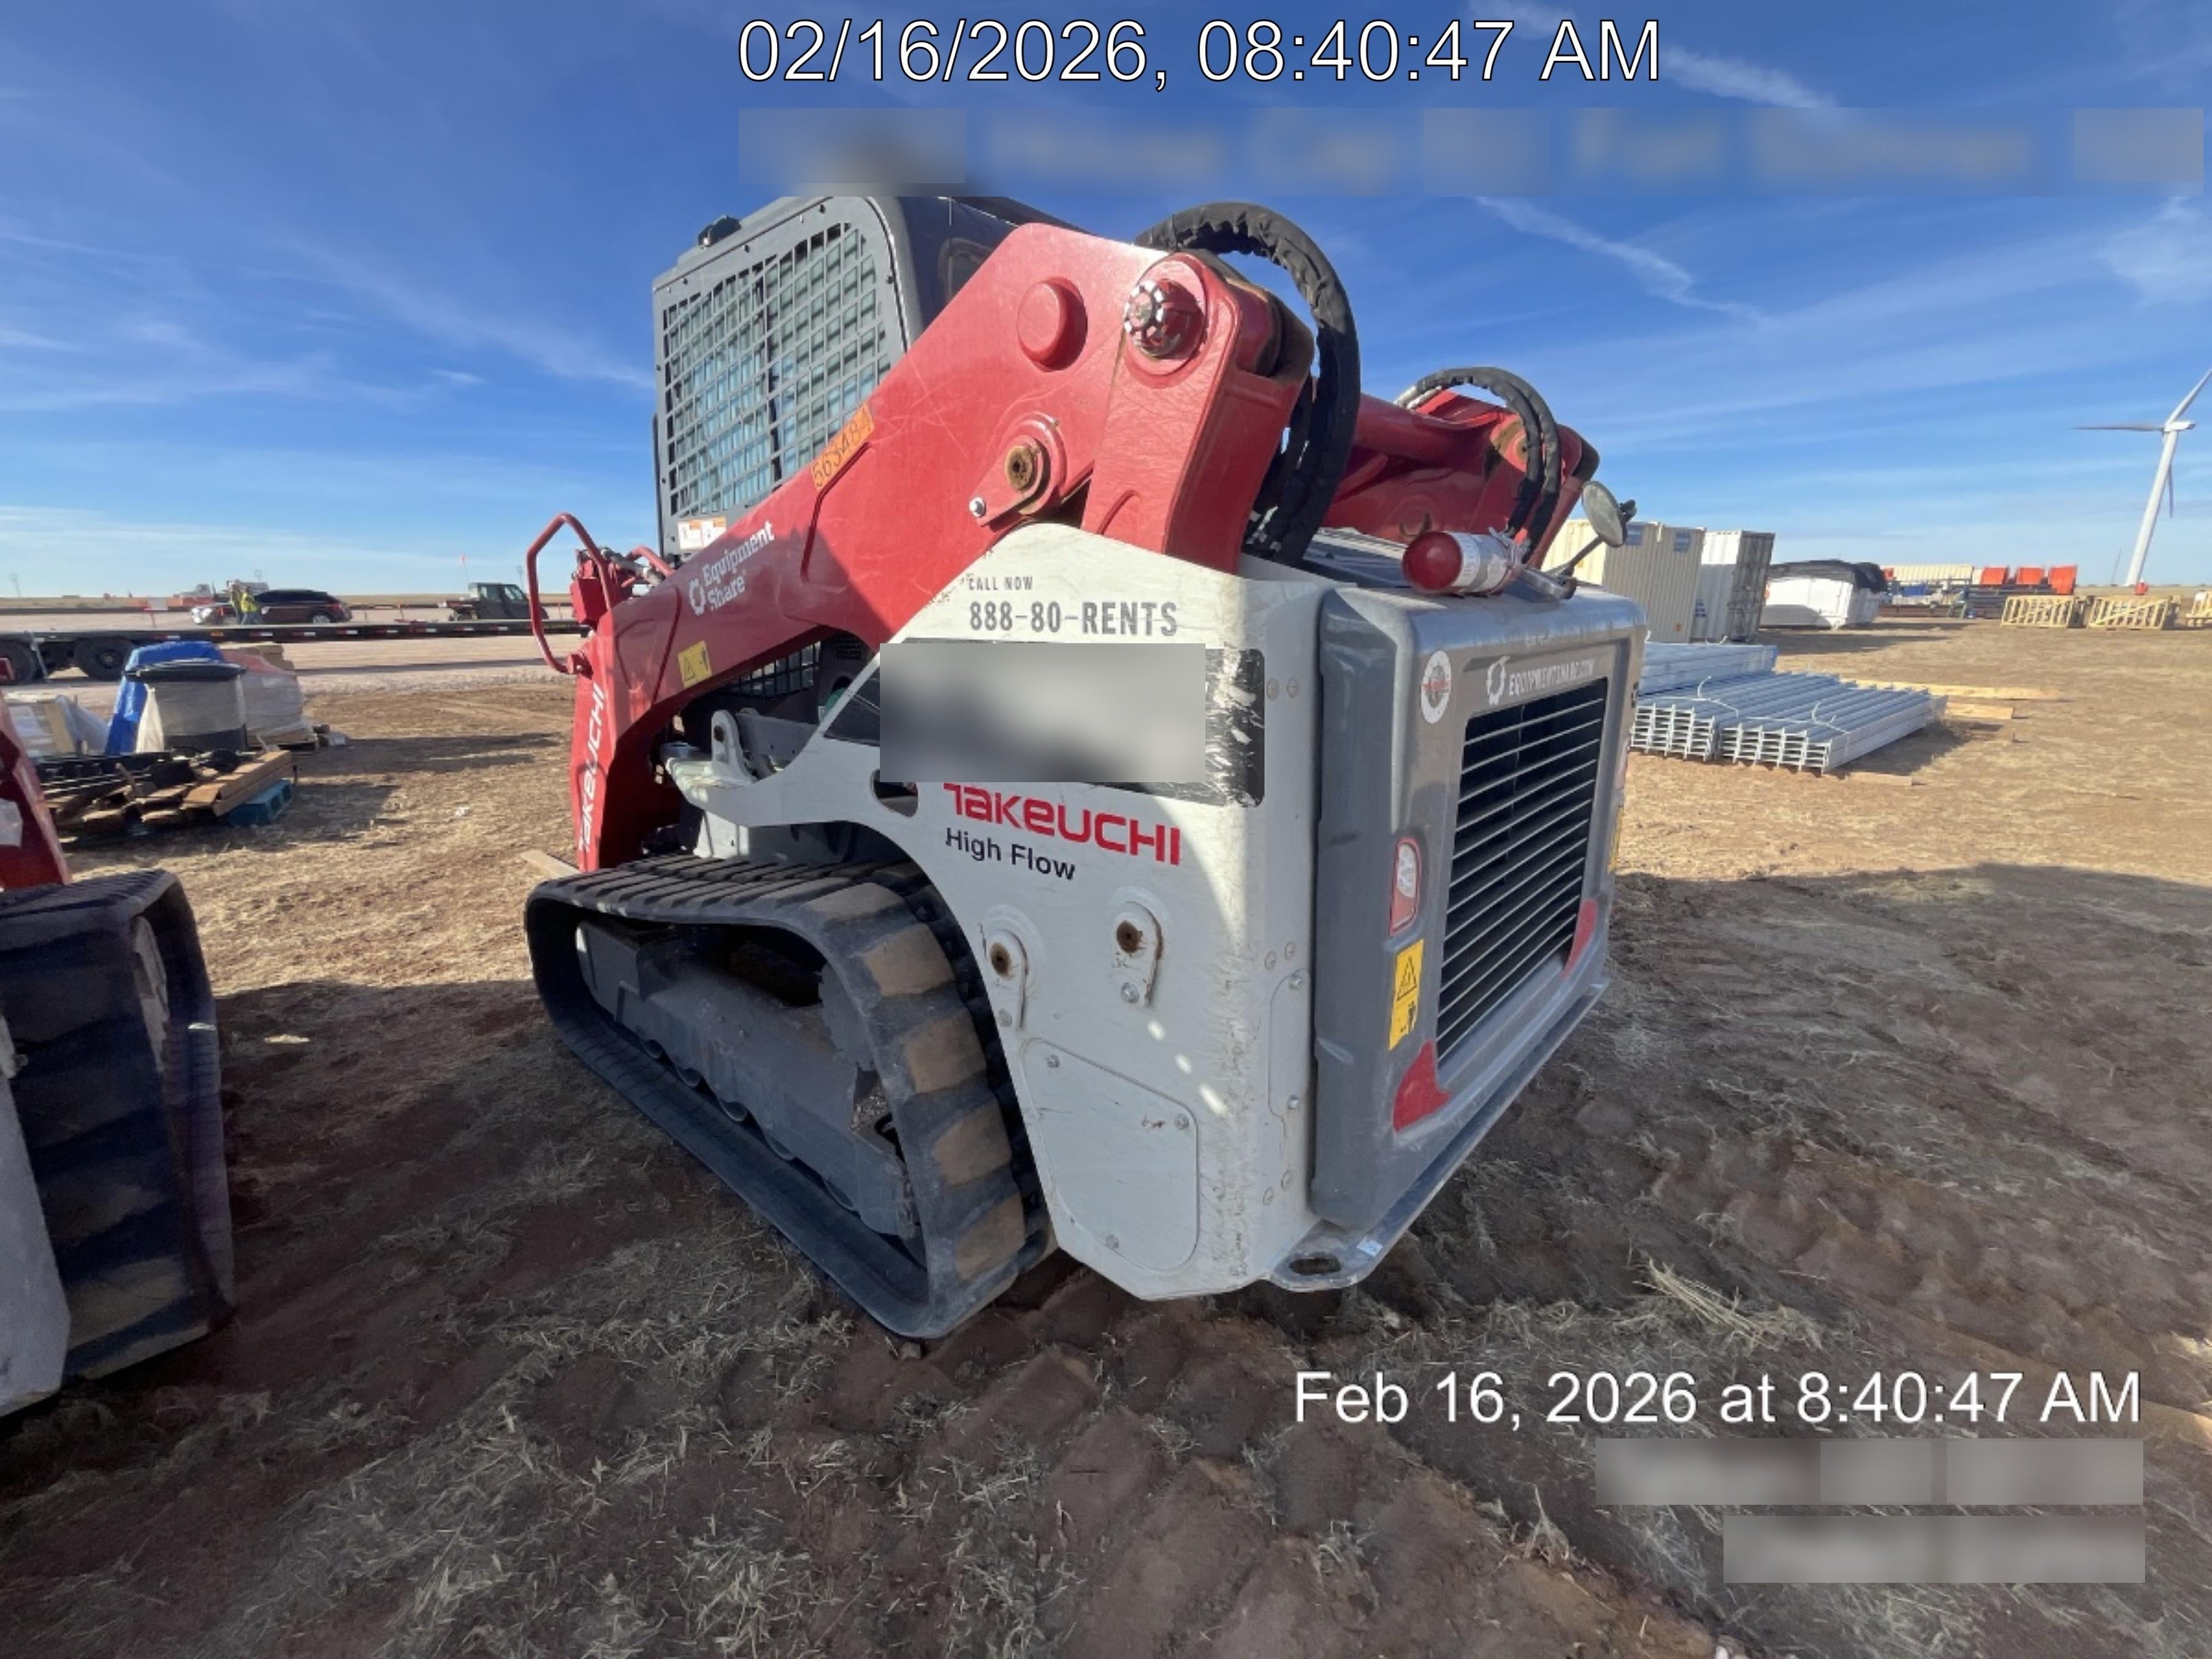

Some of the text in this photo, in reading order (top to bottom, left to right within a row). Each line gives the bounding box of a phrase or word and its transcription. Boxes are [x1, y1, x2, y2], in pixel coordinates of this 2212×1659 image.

[702, 520, 775, 586] Equipment
[707, 575, 746, 610] Share
[969, 576, 1033, 590] CALL NOW
[969, 600, 1178, 637] 888-80-RENTS
[945, 827, 1076, 880] High Flow
